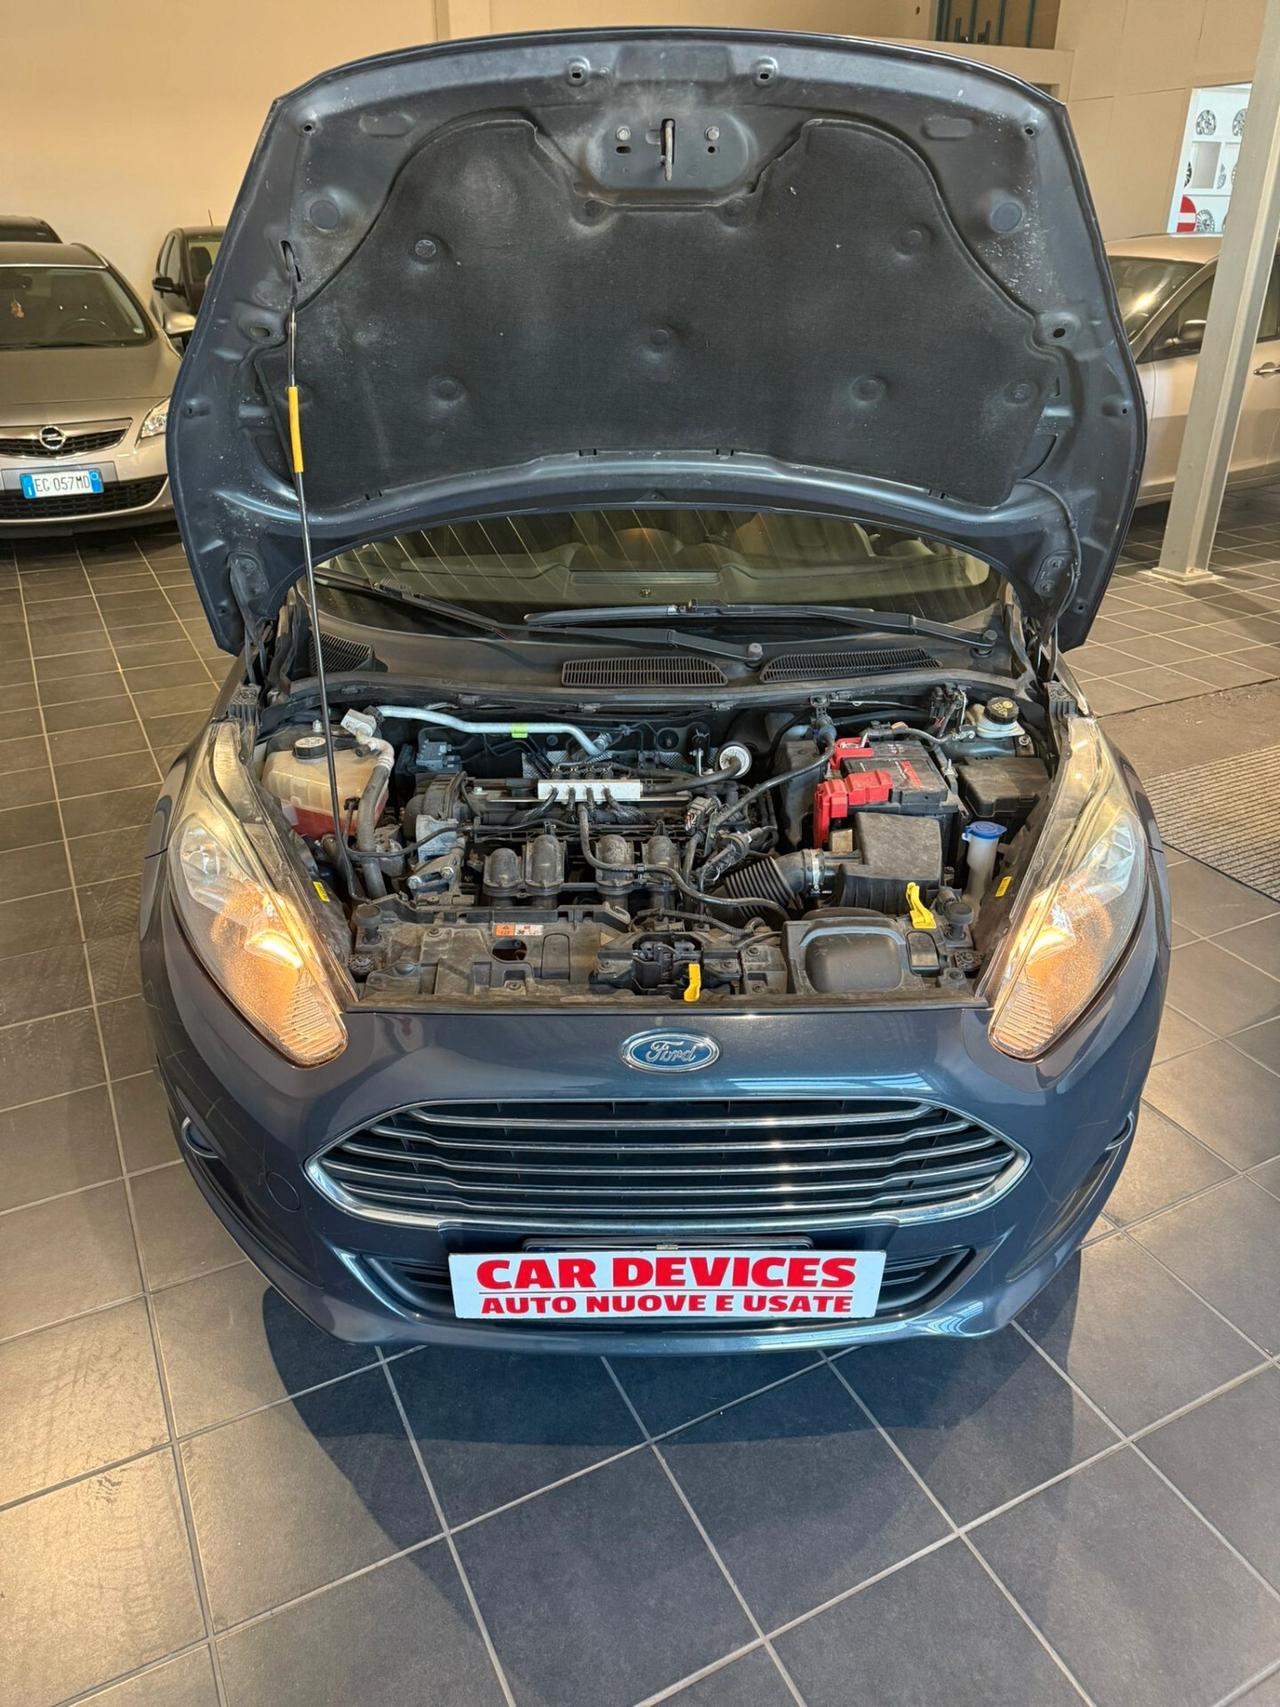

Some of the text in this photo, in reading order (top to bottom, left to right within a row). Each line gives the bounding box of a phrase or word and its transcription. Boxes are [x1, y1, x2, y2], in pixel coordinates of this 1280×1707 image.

[645, 1040, 697, 1062] Ford
[477, 1256, 857, 1290] CAR DEVICES
[481, 1295, 853, 1315] AUTO NUOVE E USATE
